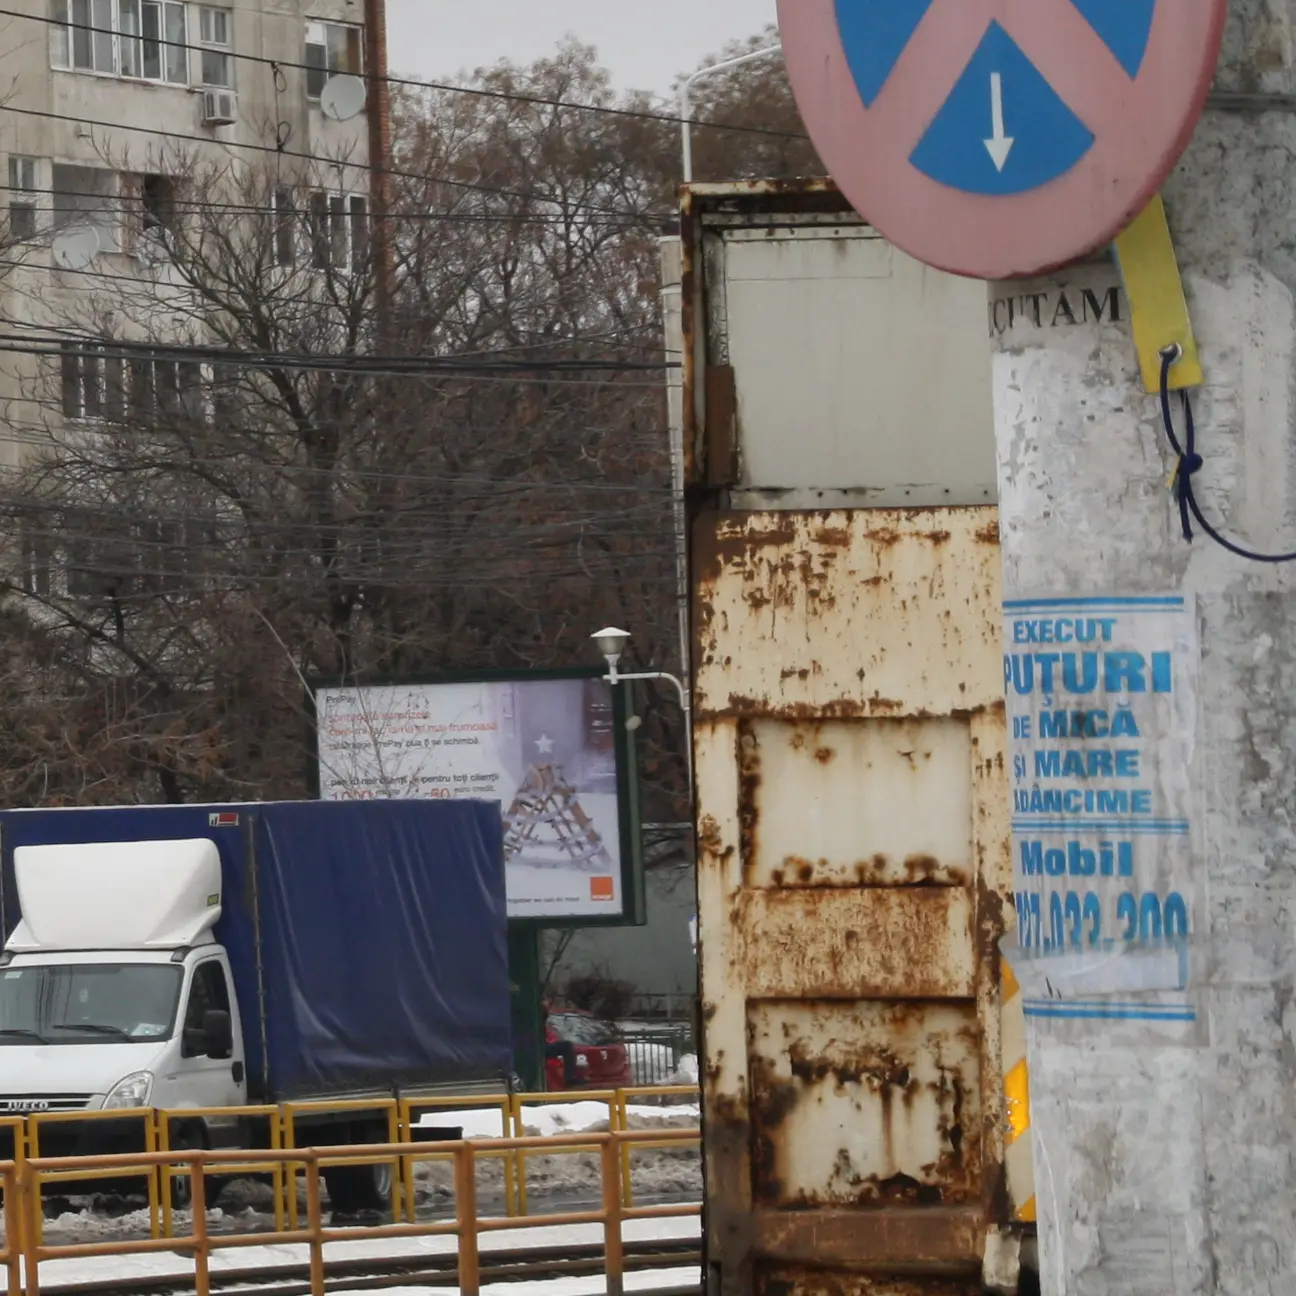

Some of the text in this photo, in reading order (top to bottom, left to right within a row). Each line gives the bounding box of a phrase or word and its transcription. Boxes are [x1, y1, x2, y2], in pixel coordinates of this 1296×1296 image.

[1013, 618, 1117, 644] EXECUT
[1013, 702, 1141, 739] DE MICĂ
[1034, 749, 1140, 778] MARE
[1020, 840, 1133, 877] Mobil
[8, 1101, 49, 1111] IVECO
